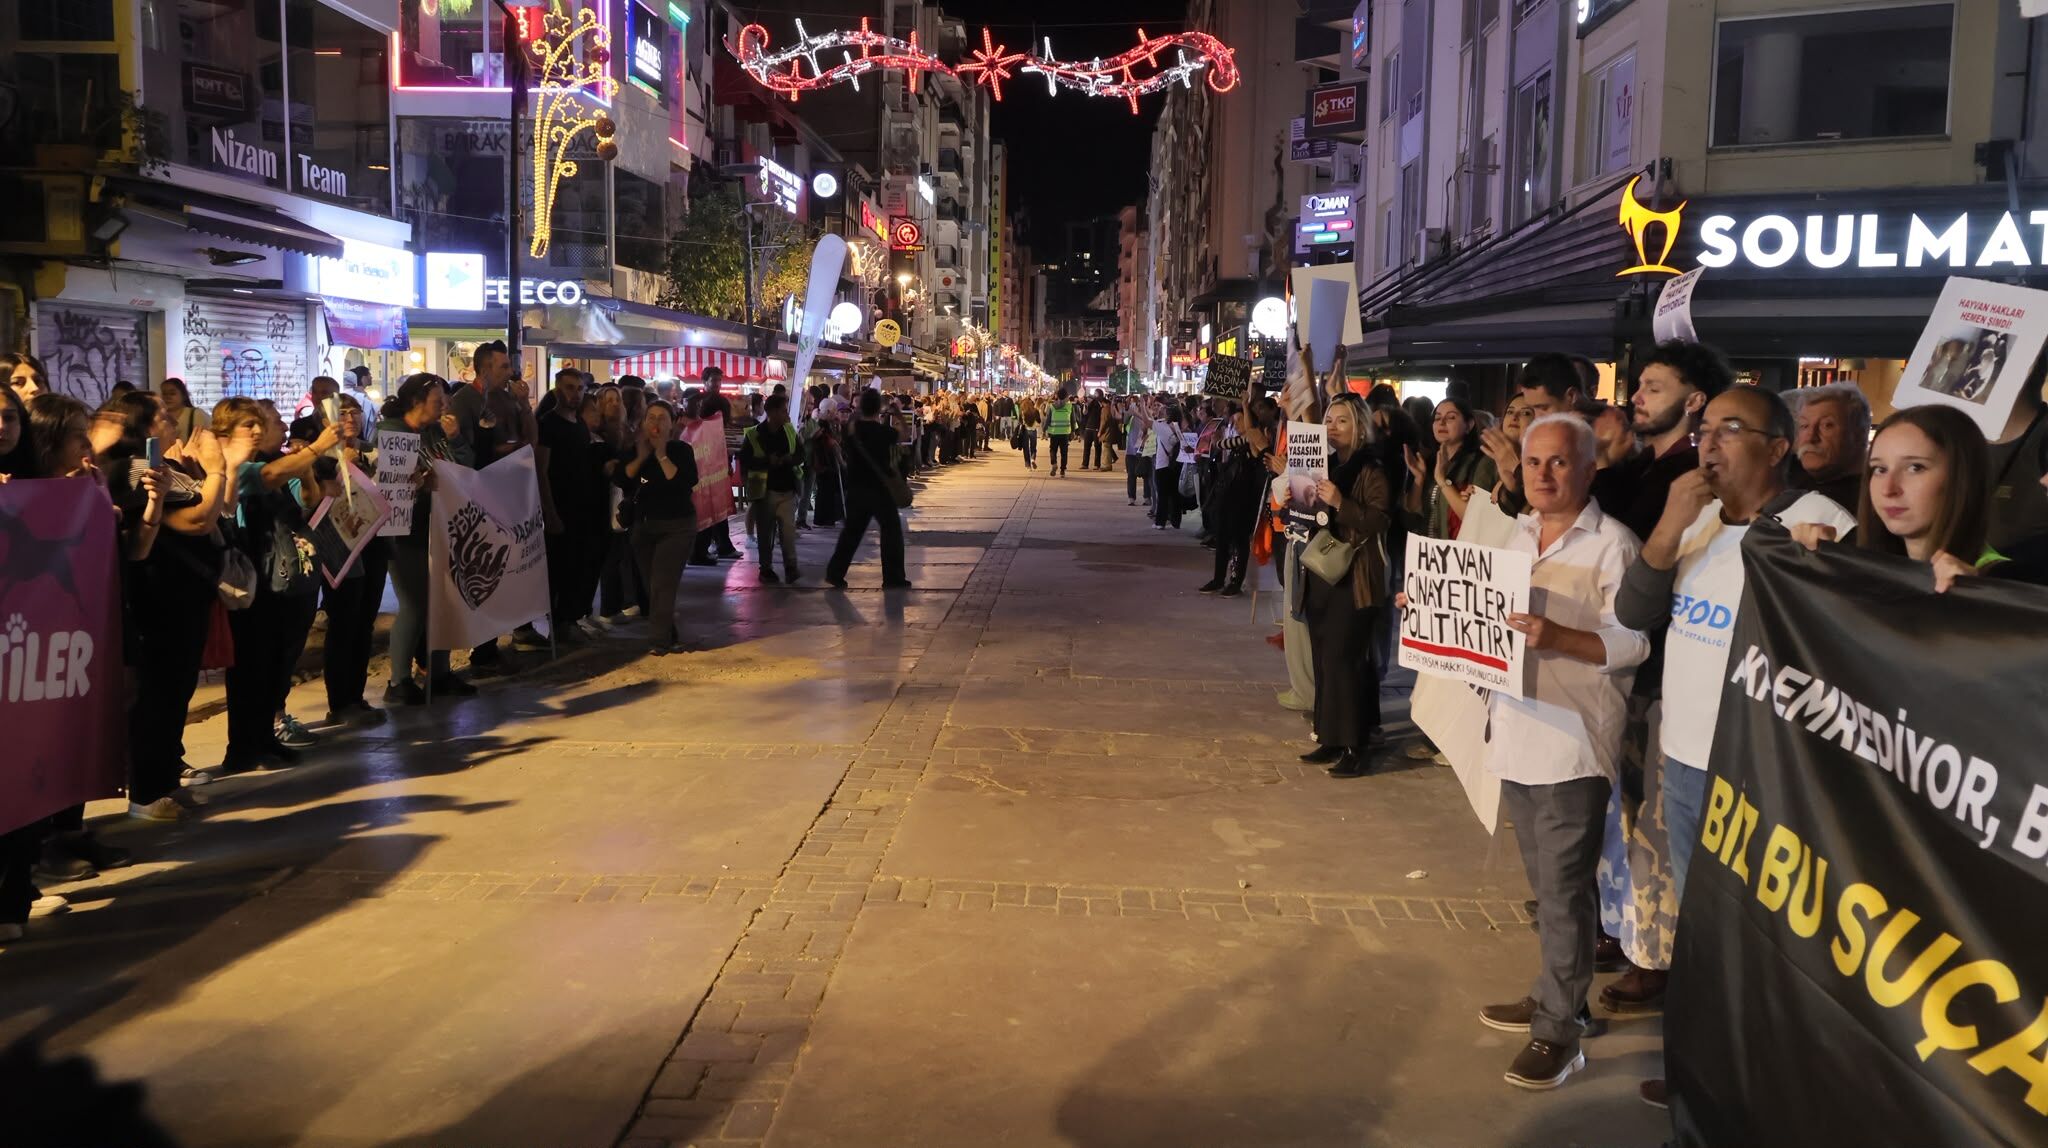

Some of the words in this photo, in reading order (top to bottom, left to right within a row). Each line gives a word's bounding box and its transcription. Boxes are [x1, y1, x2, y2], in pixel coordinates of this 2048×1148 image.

[1329, 96, 1354, 111] TKP
[211, 126, 277, 180] Nizam
[298, 153, 347, 197] Team
[1958, 298, 1990, 313] HAYVAN
[1990, 304, 2026, 320] HAKLARI
[1959, 311, 1987, 324] HEMEN
[1289, 432, 1320, 444] KATLİAM
[1288, 446, 1322, 456] YASASINI
[1288, 456, 1304, 468] GERİ
[1306, 457, 1325, 471] ÇEK!
[1402, 605, 1514, 661] POLİTİKTİR!
[1439, 659, 1465, 676] HAKKI
[1756, 823, 1828, 939] BU
